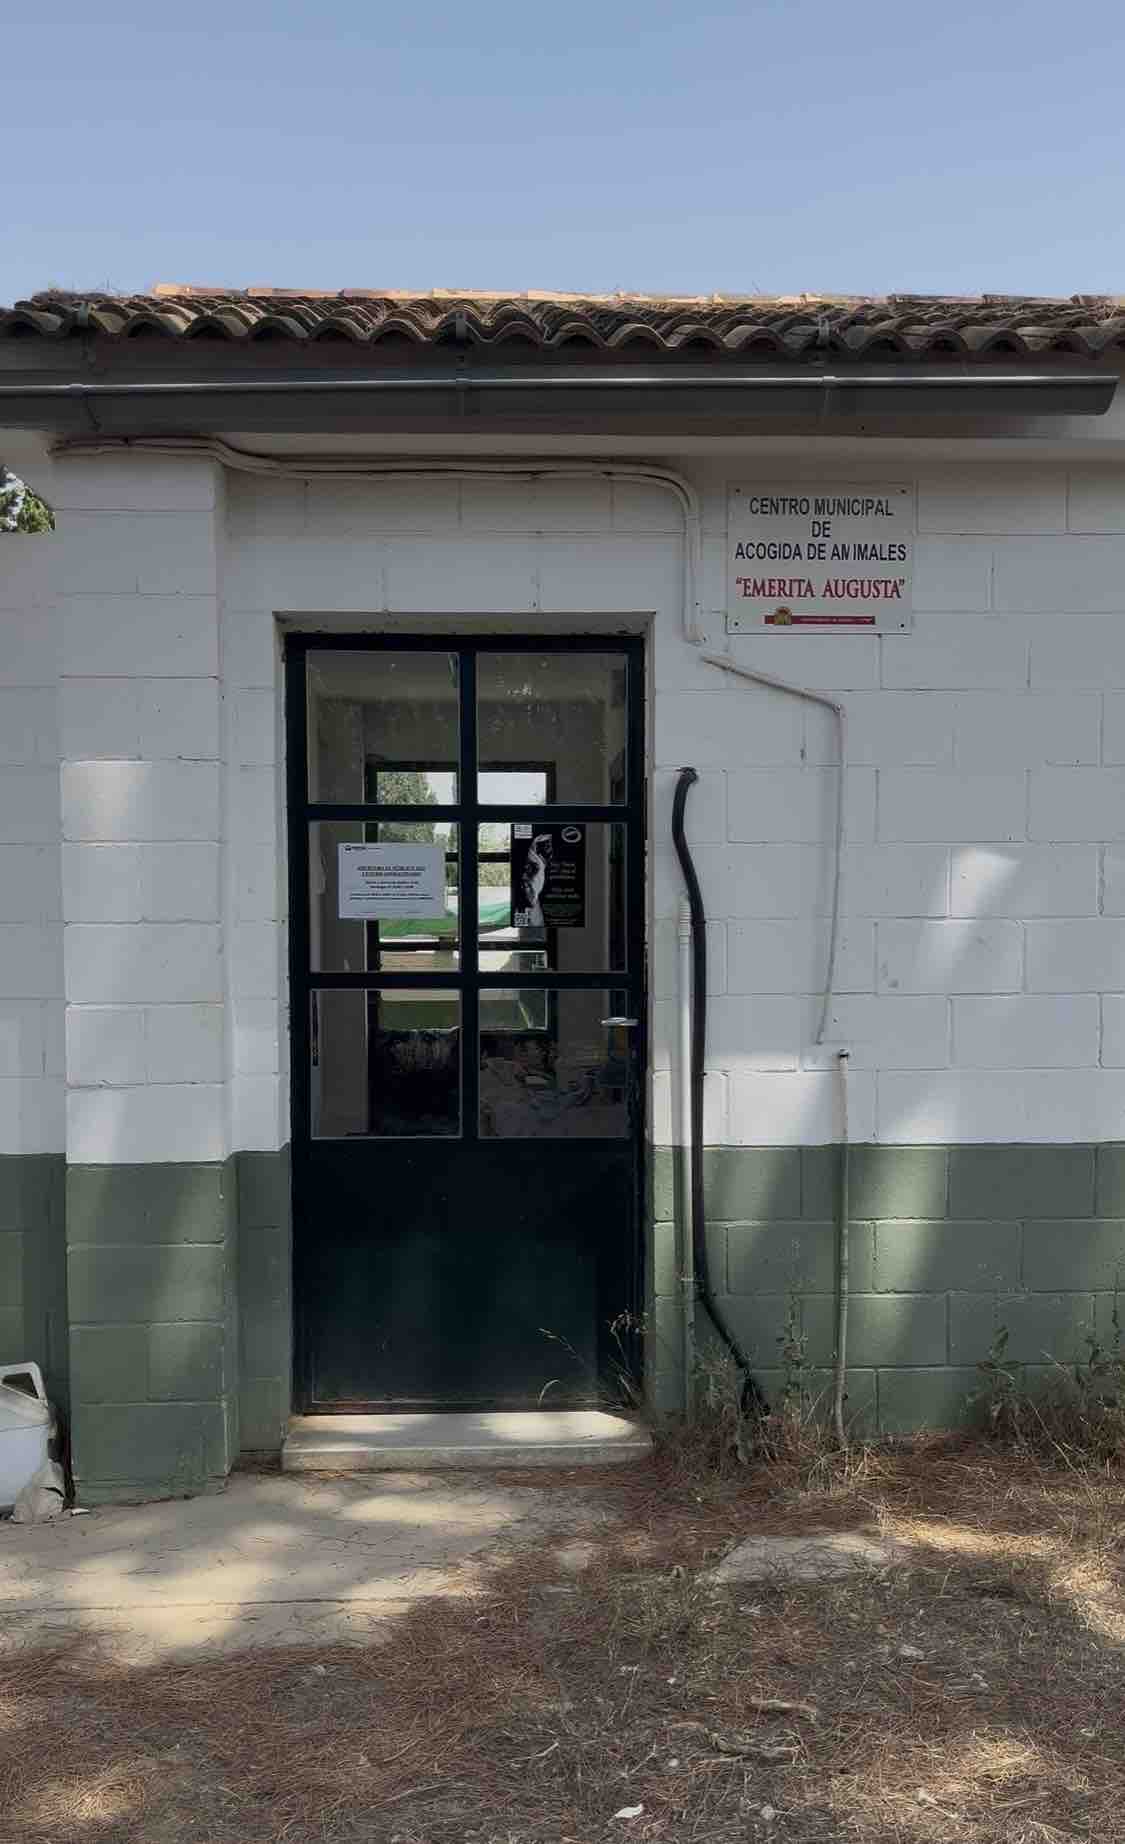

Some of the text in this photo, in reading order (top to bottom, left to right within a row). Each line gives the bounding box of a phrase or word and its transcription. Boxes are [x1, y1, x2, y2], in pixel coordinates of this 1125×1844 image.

[750, 497, 894, 516] CENTRO MUNICIPAL
[811, 521, 832, 538] DE
[735, 543, 907, 561] ACOGIDA DE ANIMALES
[736, 577, 905, 599] “EMERITA AUGUSTA”
